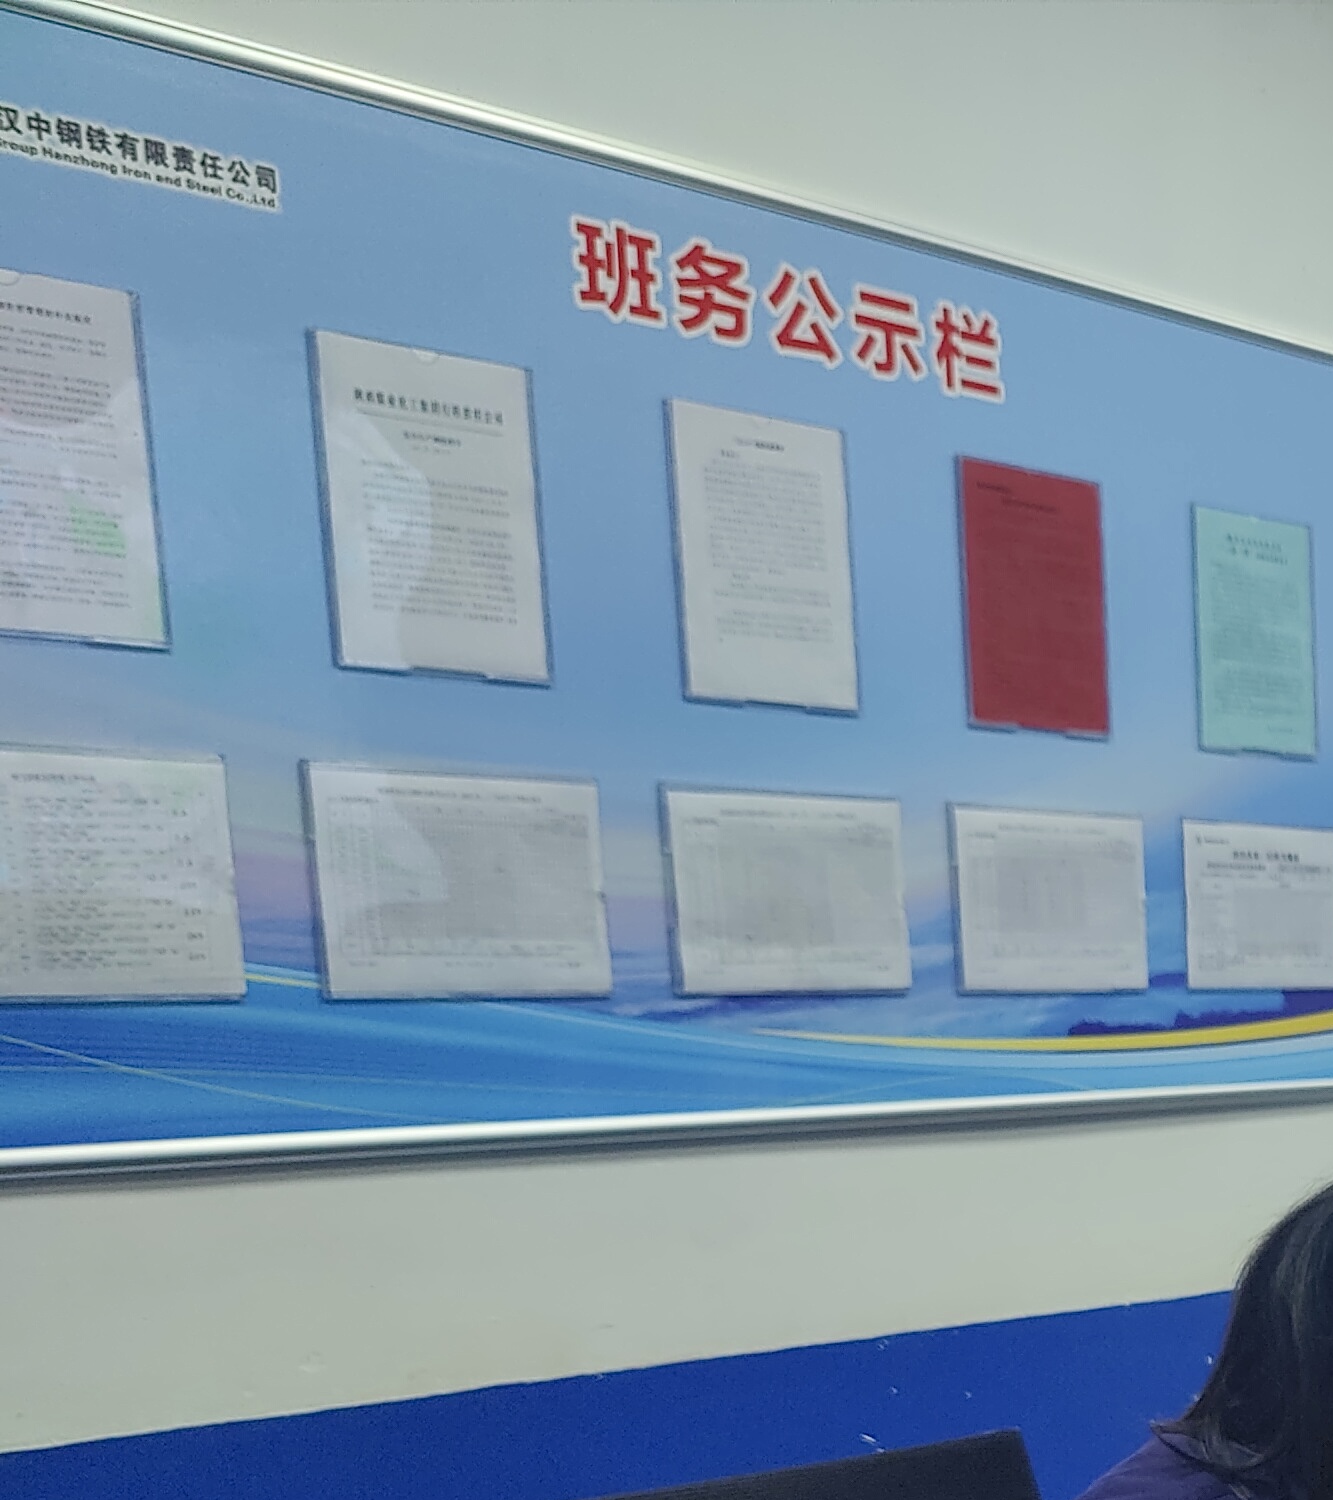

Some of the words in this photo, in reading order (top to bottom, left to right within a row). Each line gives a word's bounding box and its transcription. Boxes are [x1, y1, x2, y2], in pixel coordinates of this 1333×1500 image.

[0, 137, 39, 157] roup
[121, 164, 152, 181] Iron
[186, 178, 223, 196] Steel
[574, 220, 1001, 396] 班务公示栏
